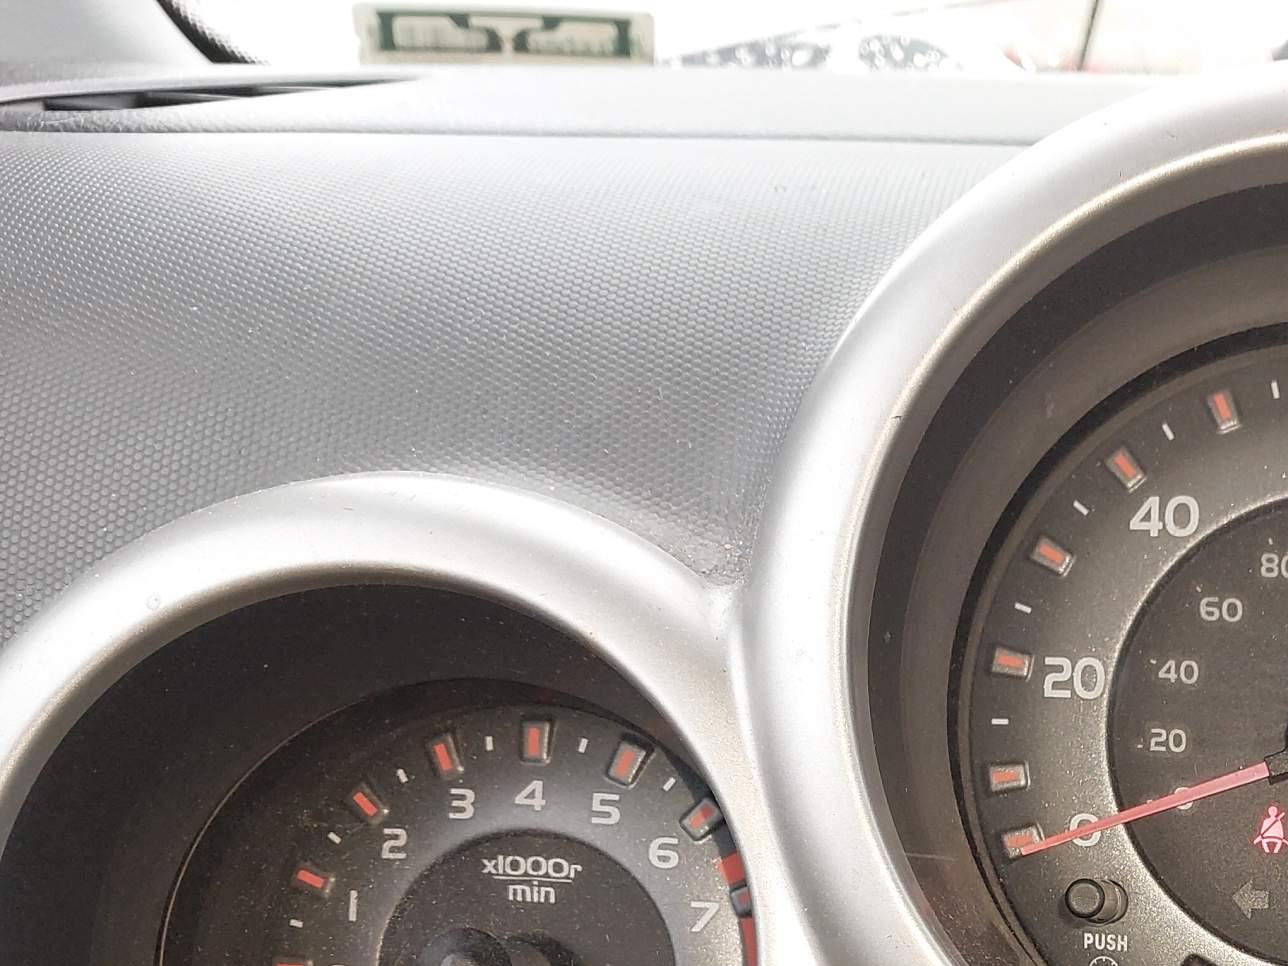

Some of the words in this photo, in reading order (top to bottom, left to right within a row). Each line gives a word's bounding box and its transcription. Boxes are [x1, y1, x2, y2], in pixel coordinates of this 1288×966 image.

[1129, 495, 1200, 538] 40
[1199, 597, 1243, 623] 60
[1043, 656, 1106, 700] 20
[1158, 660, 1199, 684] 40
[1149, 728, 1187, 752] 20
[449, 788, 475, 819] 3
[514, 780, 545, 811] 4
[592, 794, 621, 825] 5
[381, 828, 408, 859] 2
[1069, 813, 1101, 847] 0
[481, 854, 583, 878] x1000r
[649, 836, 680, 869] 6
[348, 890, 359, 922] 1
[507, 880, 556, 904] min
[690, 900, 720, 933] 7
[1083, 932, 1128, 952] PUSH
